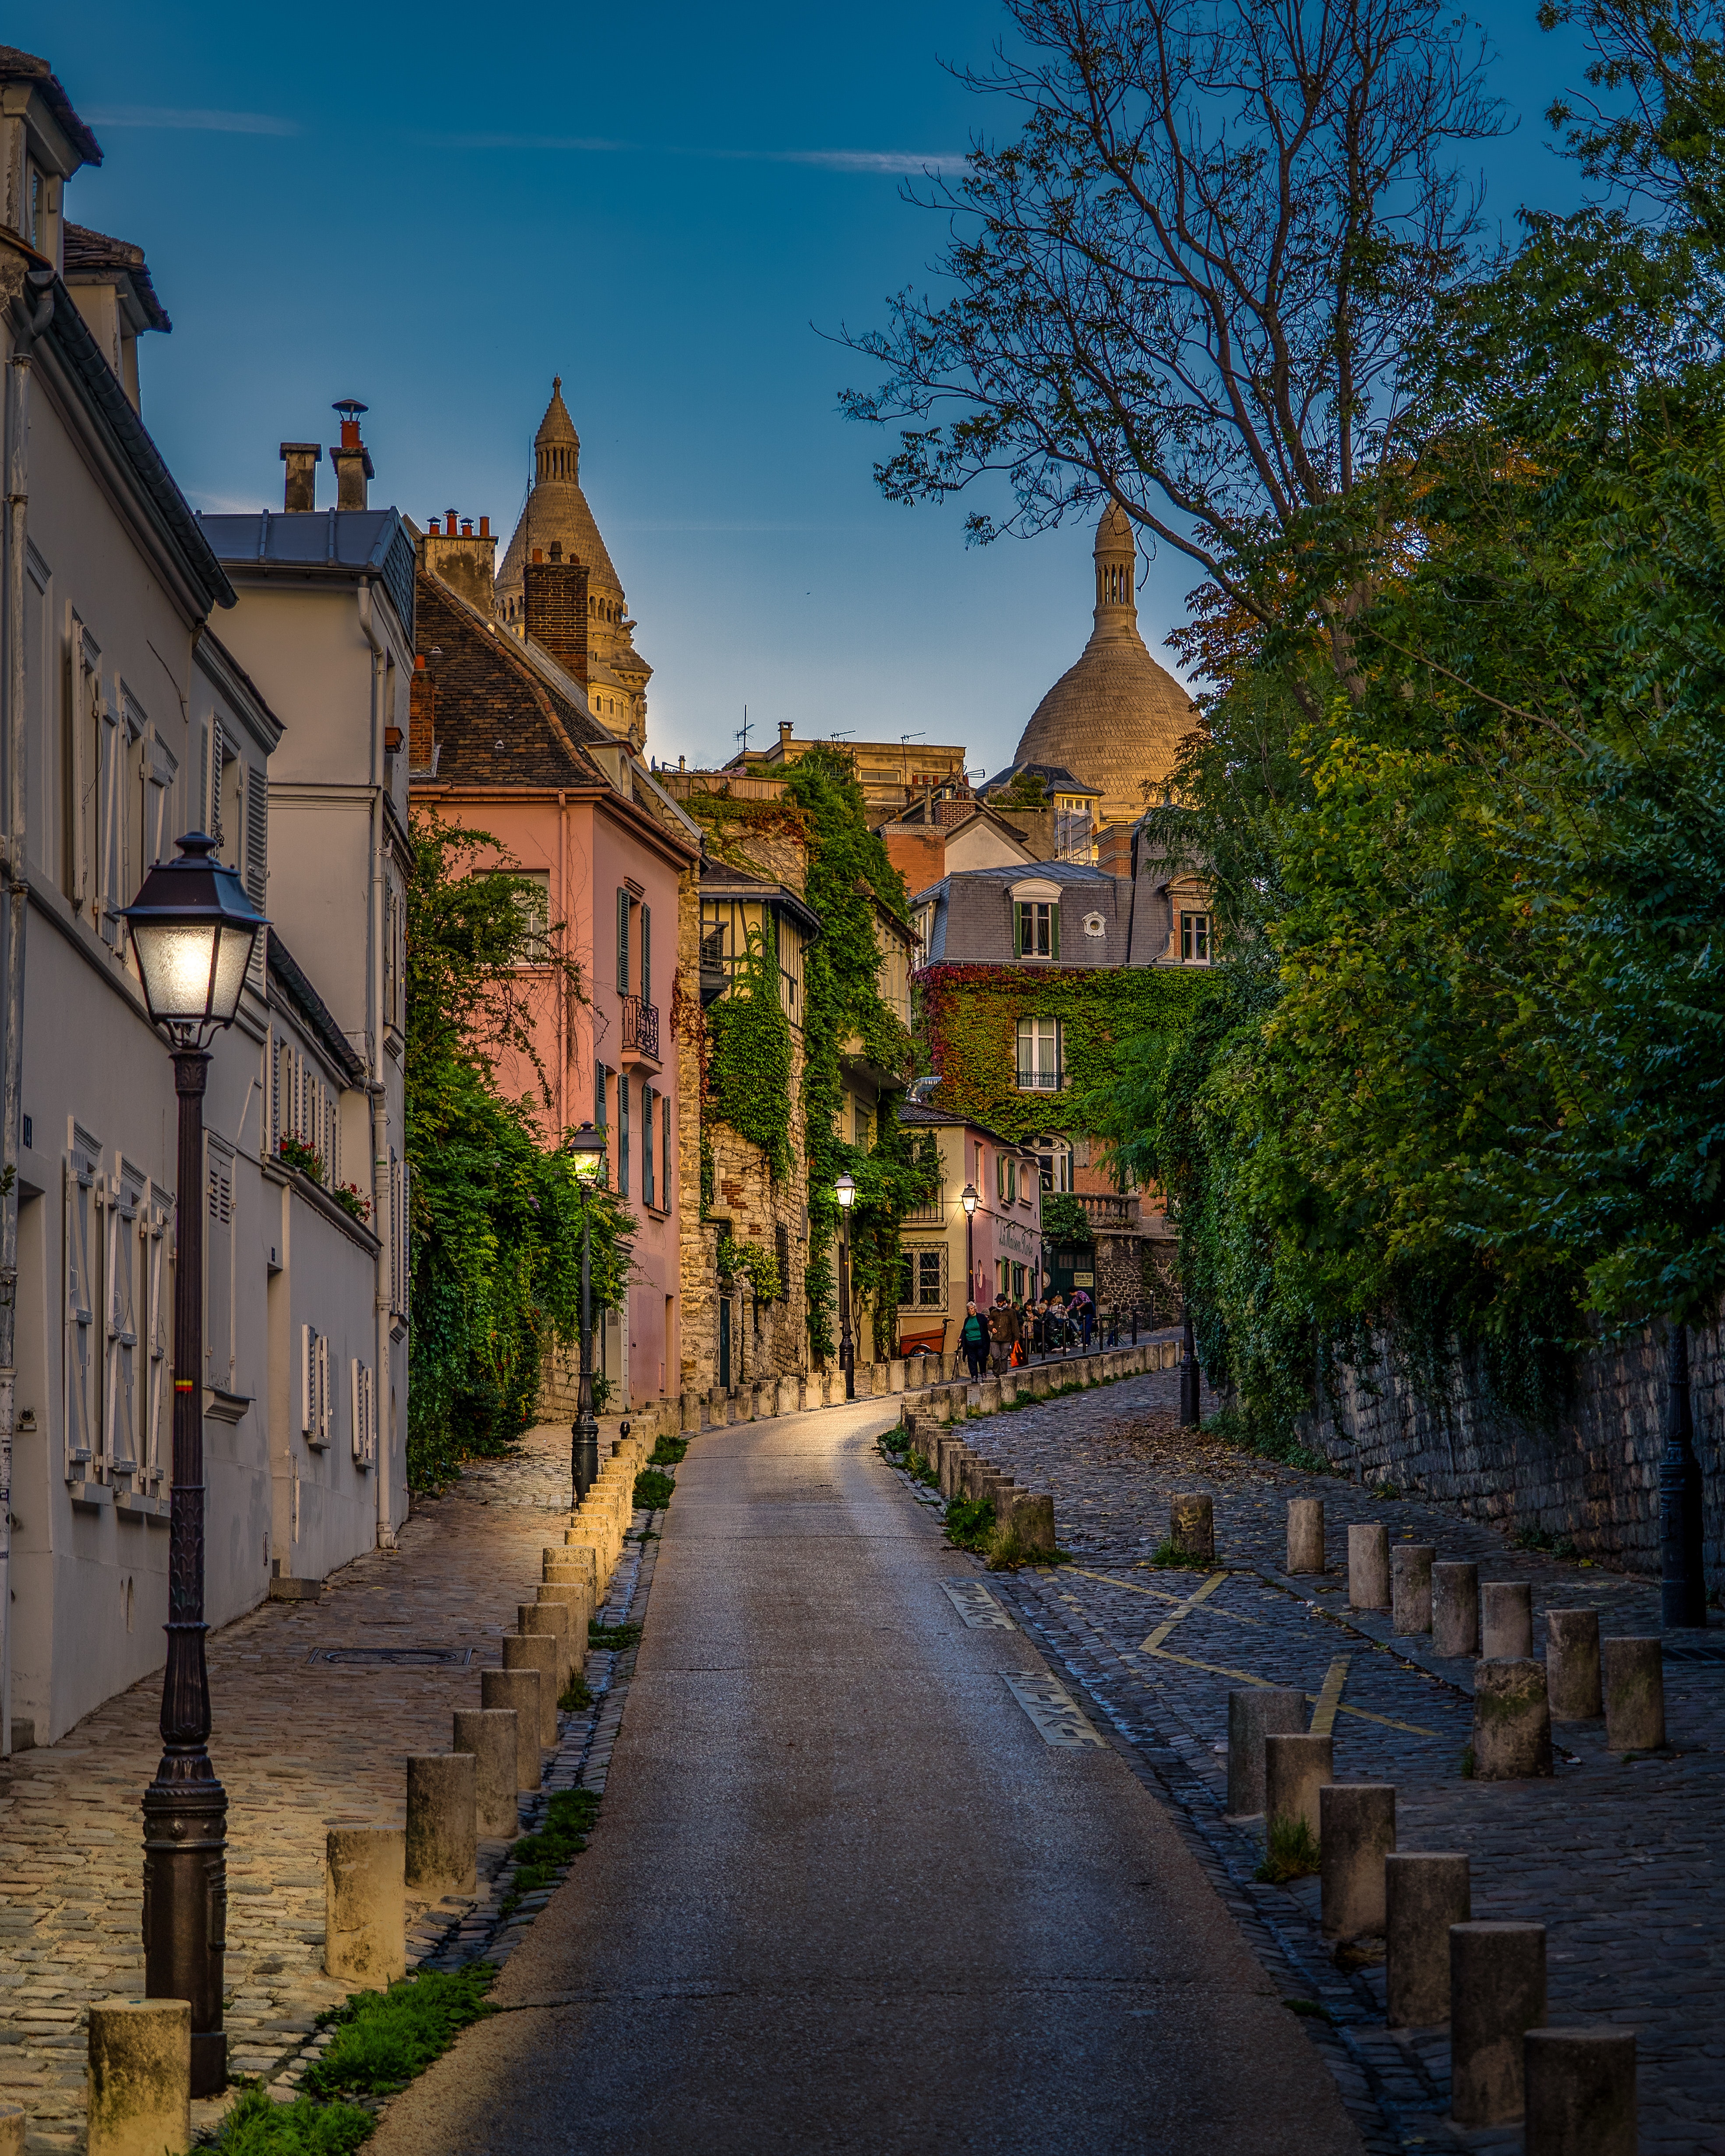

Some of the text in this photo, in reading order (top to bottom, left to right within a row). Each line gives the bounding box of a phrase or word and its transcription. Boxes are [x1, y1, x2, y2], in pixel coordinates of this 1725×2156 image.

[25, 1118, 31, 1147] 14
[999, 1221, 1033, 1258] La Maison Rose
